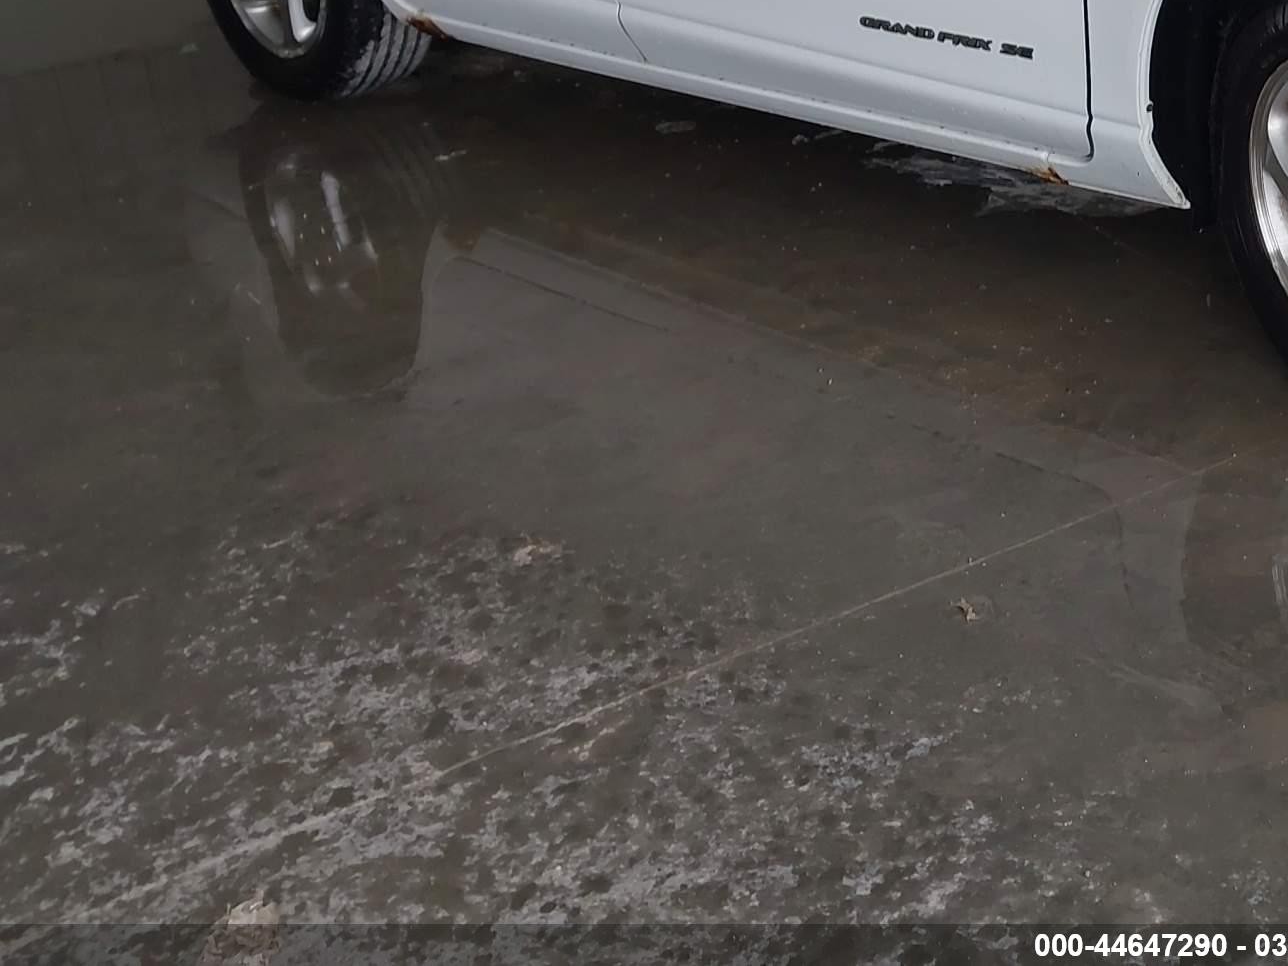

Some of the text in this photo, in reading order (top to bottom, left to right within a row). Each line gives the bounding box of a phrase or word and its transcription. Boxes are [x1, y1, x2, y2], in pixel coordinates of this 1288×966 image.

[859, 15, 1034, 60] GRAND PRIX SE
